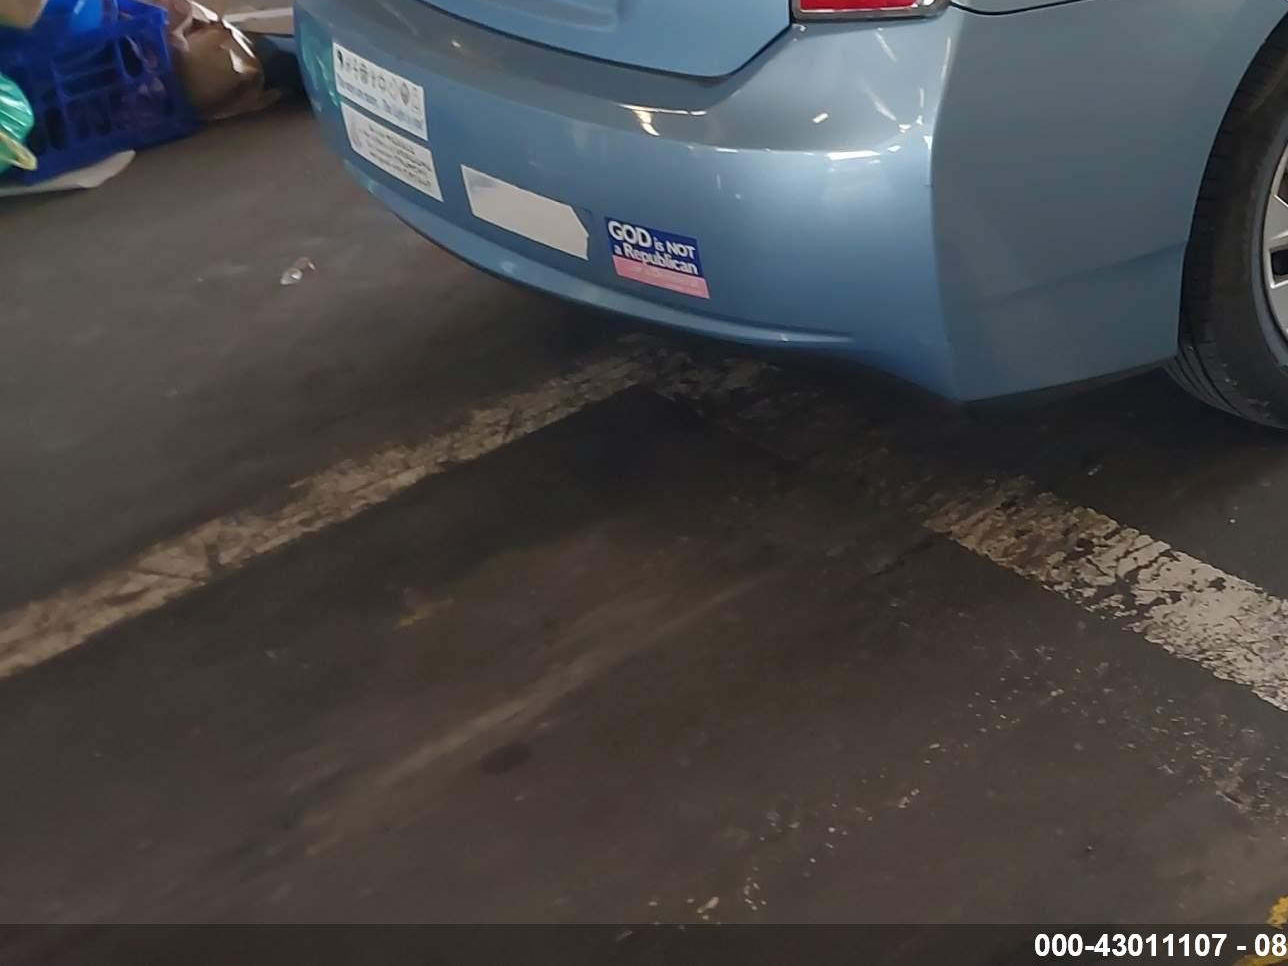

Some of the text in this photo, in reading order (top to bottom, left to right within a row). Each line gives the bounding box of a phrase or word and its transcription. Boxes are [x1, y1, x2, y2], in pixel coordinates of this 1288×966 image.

[607, 220, 697, 260] GOD is NOT
[613, 241, 699, 276] a Republican
